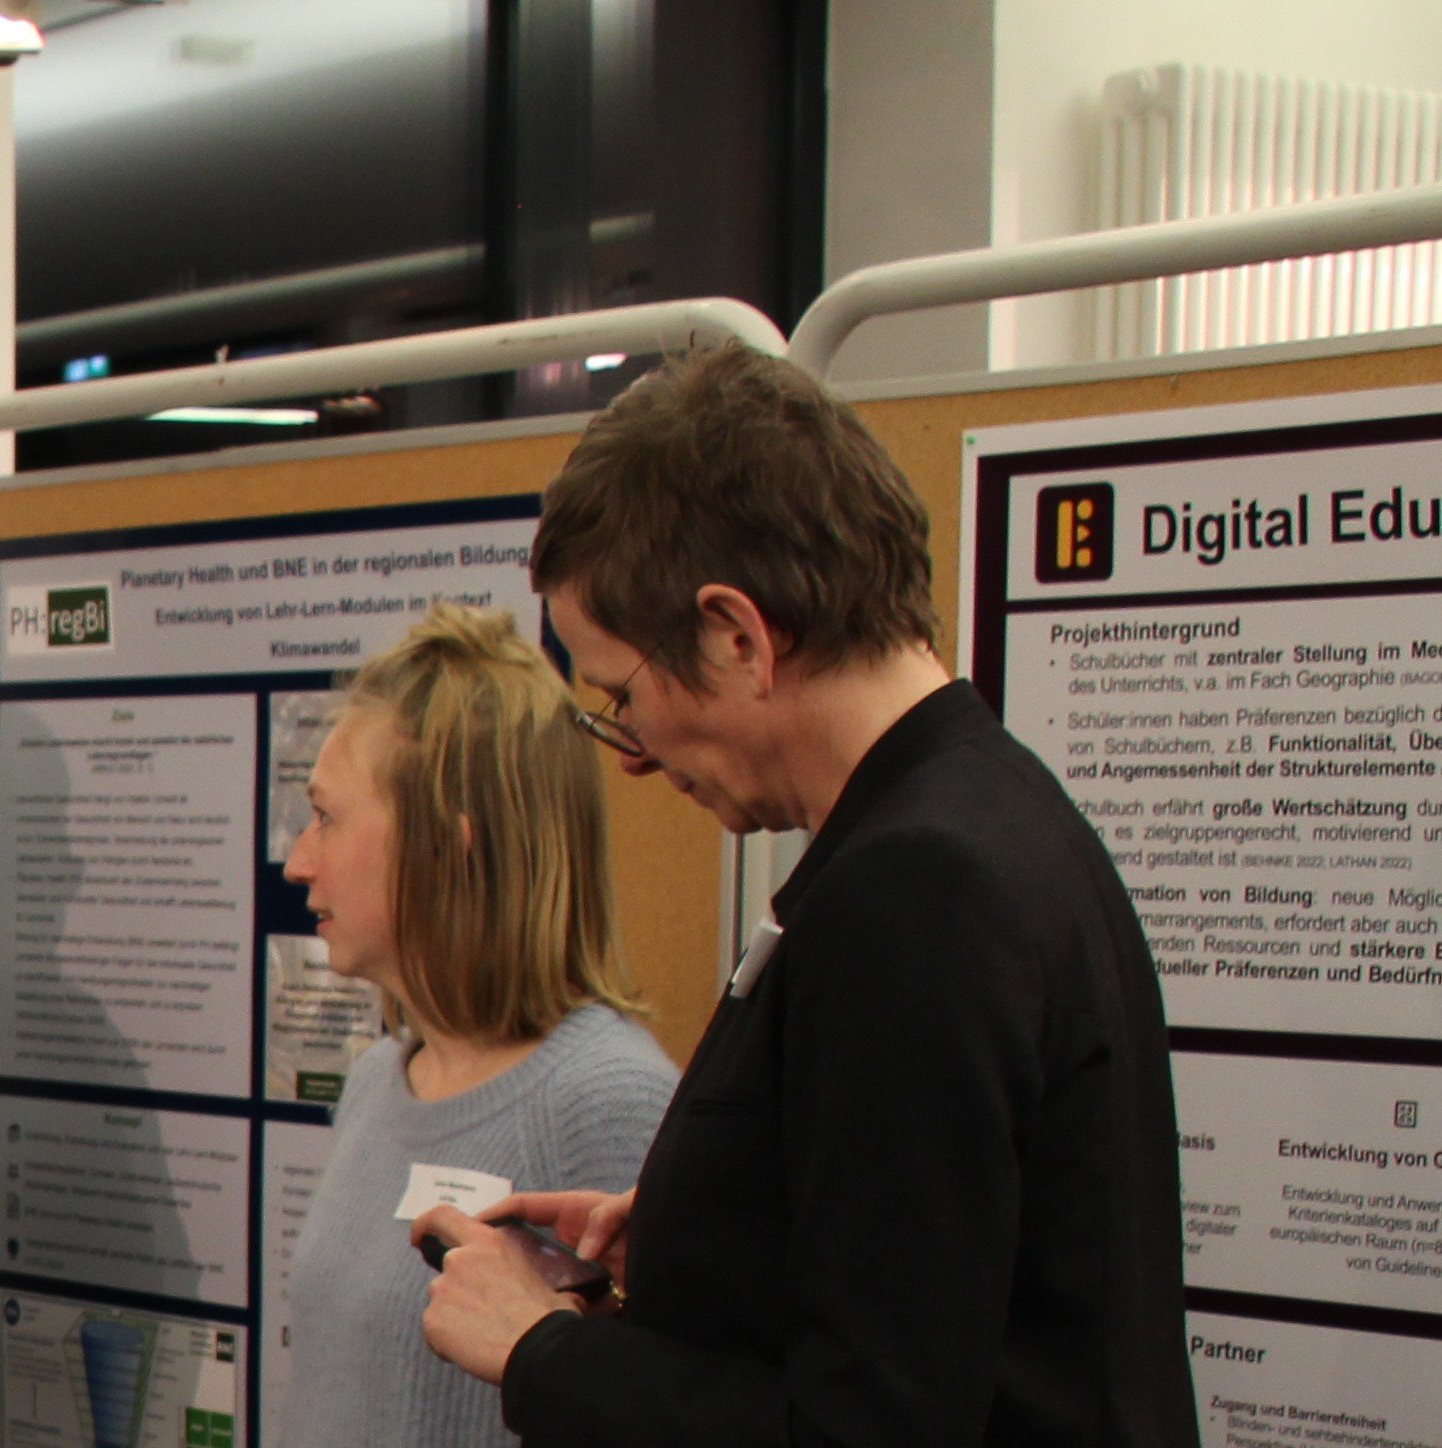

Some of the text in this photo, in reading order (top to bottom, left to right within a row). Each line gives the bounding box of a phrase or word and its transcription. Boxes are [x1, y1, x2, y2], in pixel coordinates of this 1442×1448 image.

[1142, 493, 1309, 565] Digital
[120, 568, 185, 590] Planetary
[188, 563, 235, 583] Health
[239, 561, 269, 580] und
[273, 556, 308, 578] BNE
[313, 559, 328, 576] in
[333, 555, 358, 574] der
[363, 549, 455, 576] regionalen
[156, 606, 234, 625] Entwicklung
[238, 605, 263, 619] von
[1051, 617, 1240, 647] Projekthintergrund
[270, 637, 361, 658] Klimawandel
[1070, 641, 1400, 671] Schulbücher mit zentraler Stellung im
[1069, 678, 1096, 695] des
[1226, 672, 1245, 690] im
[1251, 671, 1291, 689] Fach
[1296, 668, 1396, 691] Geographie
[1179, 708, 1229, 727] haben
[1236, 706, 1336, 728] Präferenzen
[1344, 704, 1425, 727] bezüglich
[1067, 740, 1094, 755] von
[1269, 733, 1396, 754] Funktionalität,
[1067, 759, 1436, 783] und Angemessenheit der Strukturelemente
[1153, 797, 1407, 821] erfährt große Wertschätzung
[1116, 824, 1412, 845] es zielgruppengerecht, motivierend
[1147, 850, 1214, 870] gestaltet
[1218, 852, 1236, 866] ist
[1199, 888, 1231, 903] von
[1331, 889, 1374, 905] neue
[1274, 913, 1438, 934] erfordert aber auch
[1203, 934, 1425, 960] Ressourcen und stärkere
[1215, 959, 1319, 981] Präferenzen
[1327, 964, 1362, 982] und
[1278, 1138, 1427, 1169] Entwicklung von
[1282, 1184, 1395, 1210] Entwicklung und
[1288, 1206, 1411, 1233] Kriterienkataloges
[1269, 1226, 1408, 1251] europäischen Raum
[1346, 1256, 1371, 1271] von
[1189, 1335, 1266, 1364] Partner
[1210, 1394, 1387, 1432] Zugang und Barrierefreiheit
